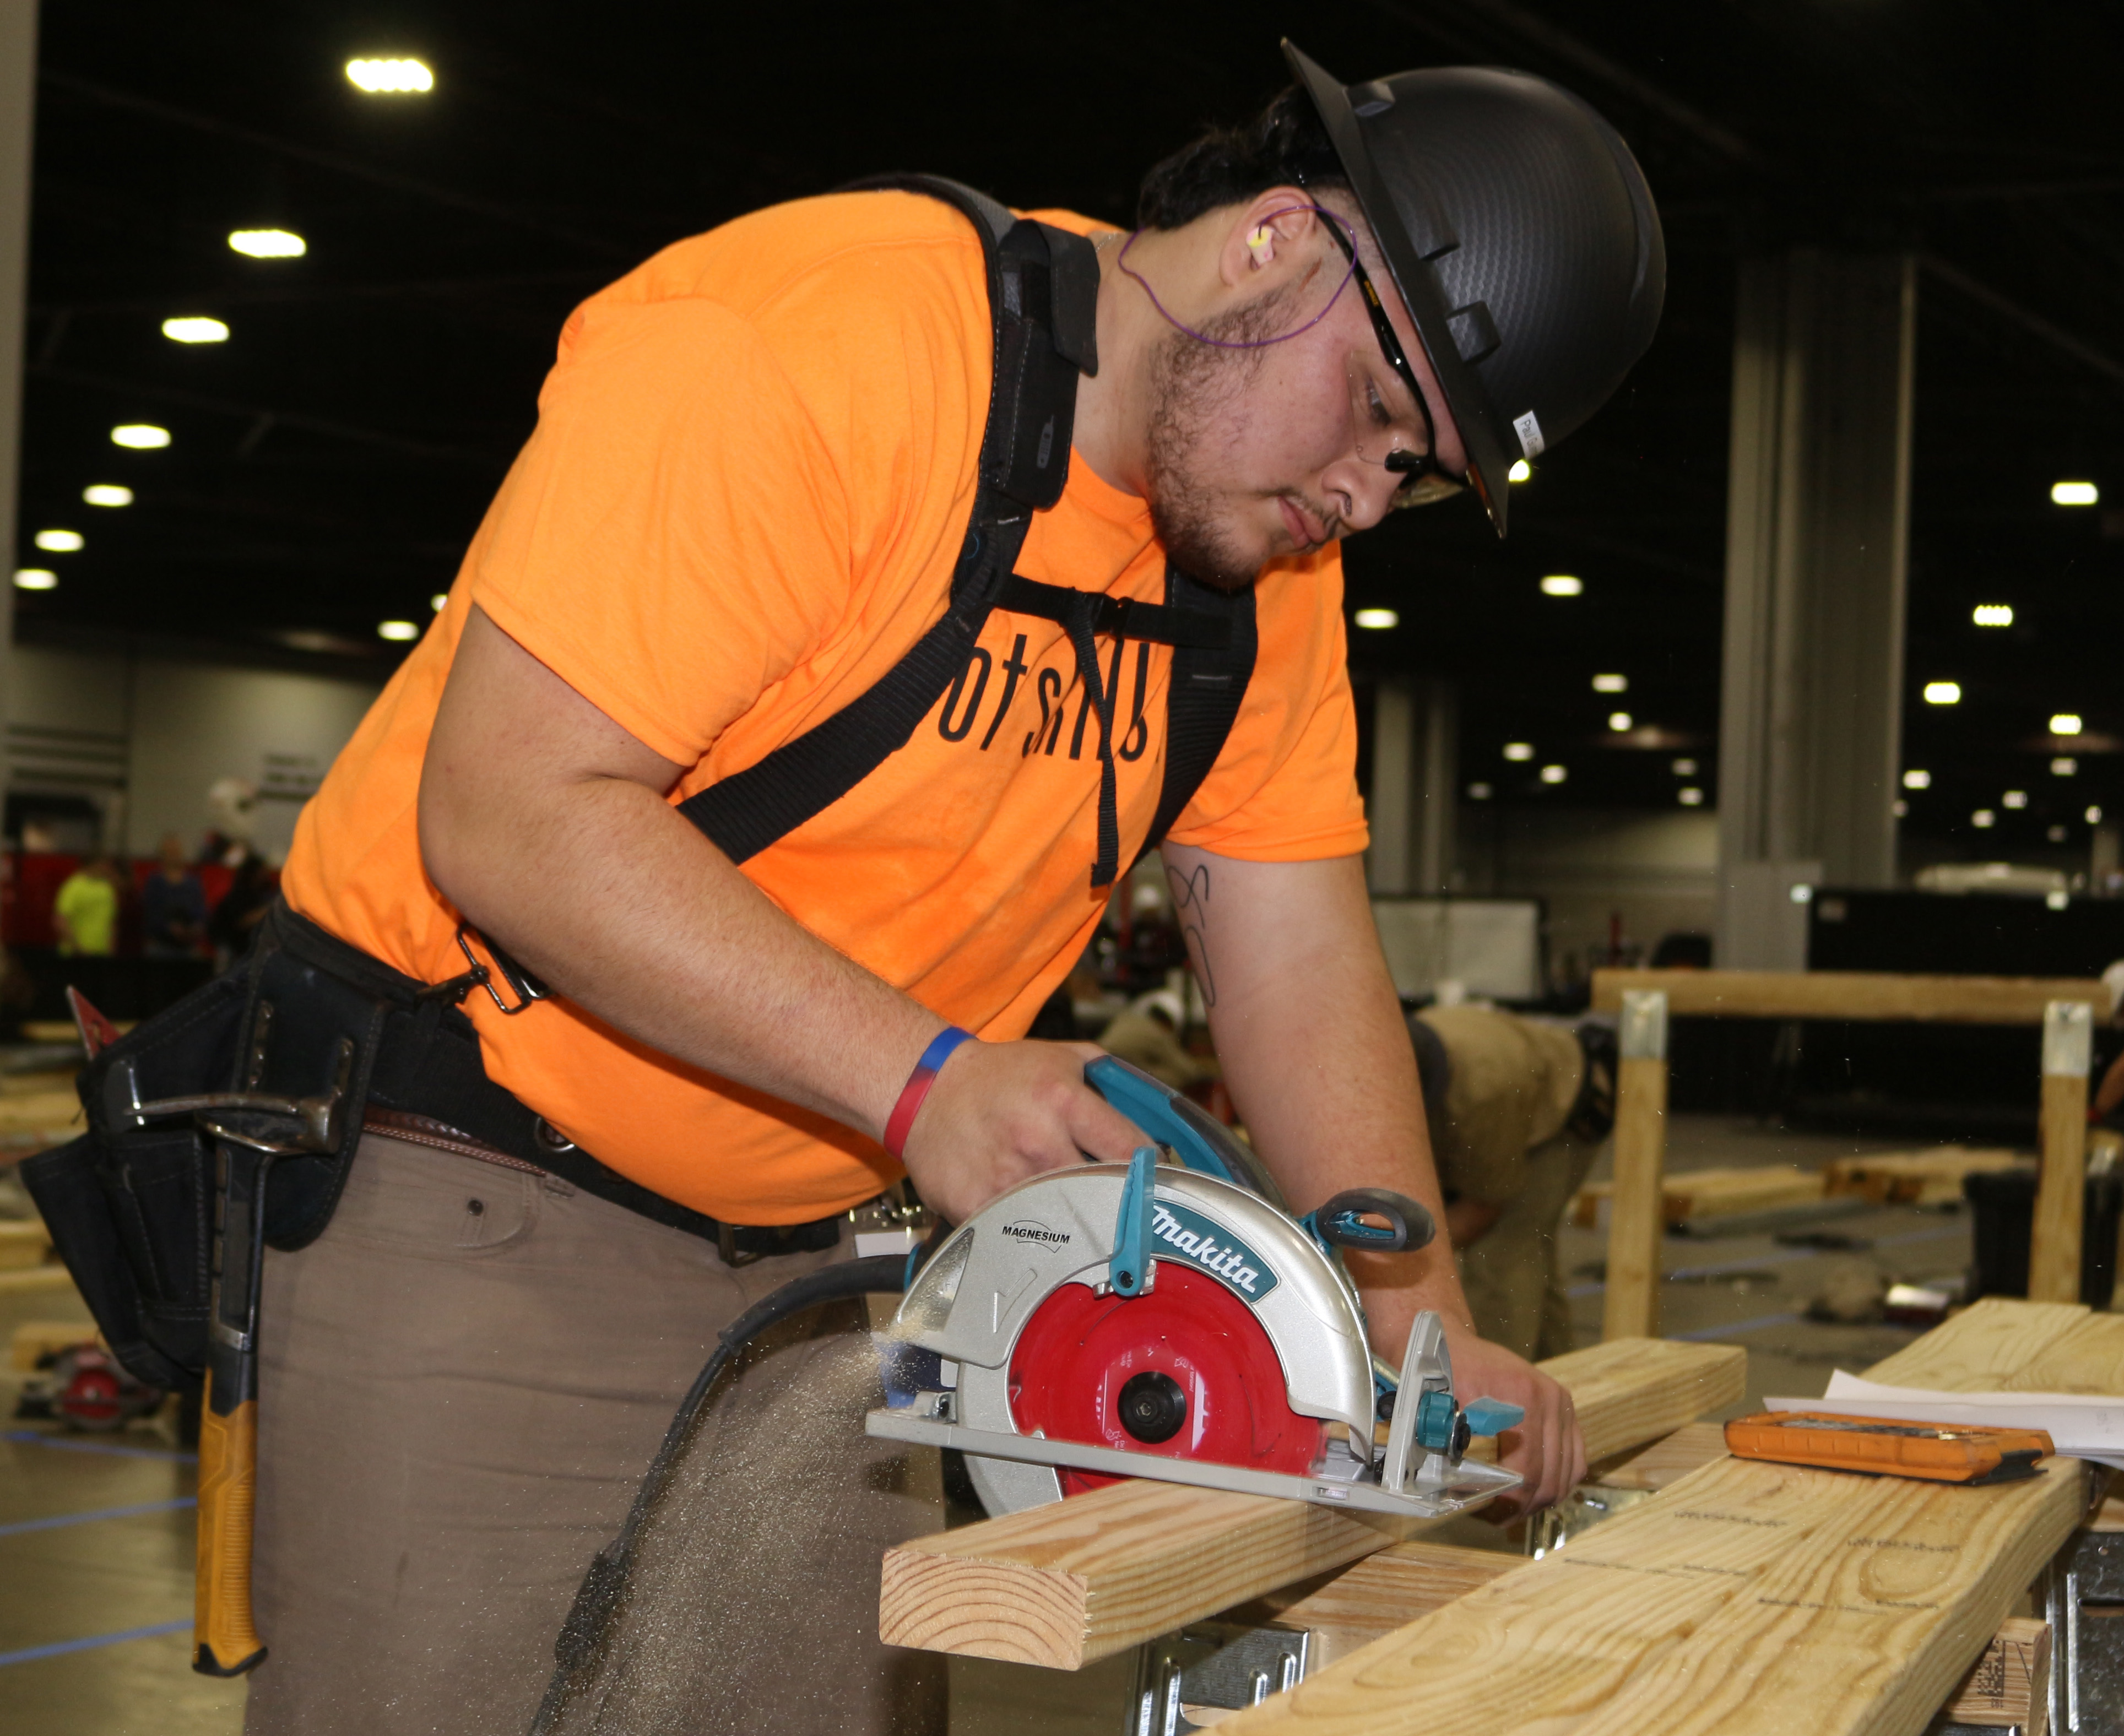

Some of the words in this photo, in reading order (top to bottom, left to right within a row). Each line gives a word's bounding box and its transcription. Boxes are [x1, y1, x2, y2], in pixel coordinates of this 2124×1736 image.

[1520, 419, 1536, 438] Paul
[939, 634, 1028, 750] ot
[1002, 1226, 1070, 1244] MAGNESIUM
[1153, 1204, 1259, 1293] makita
